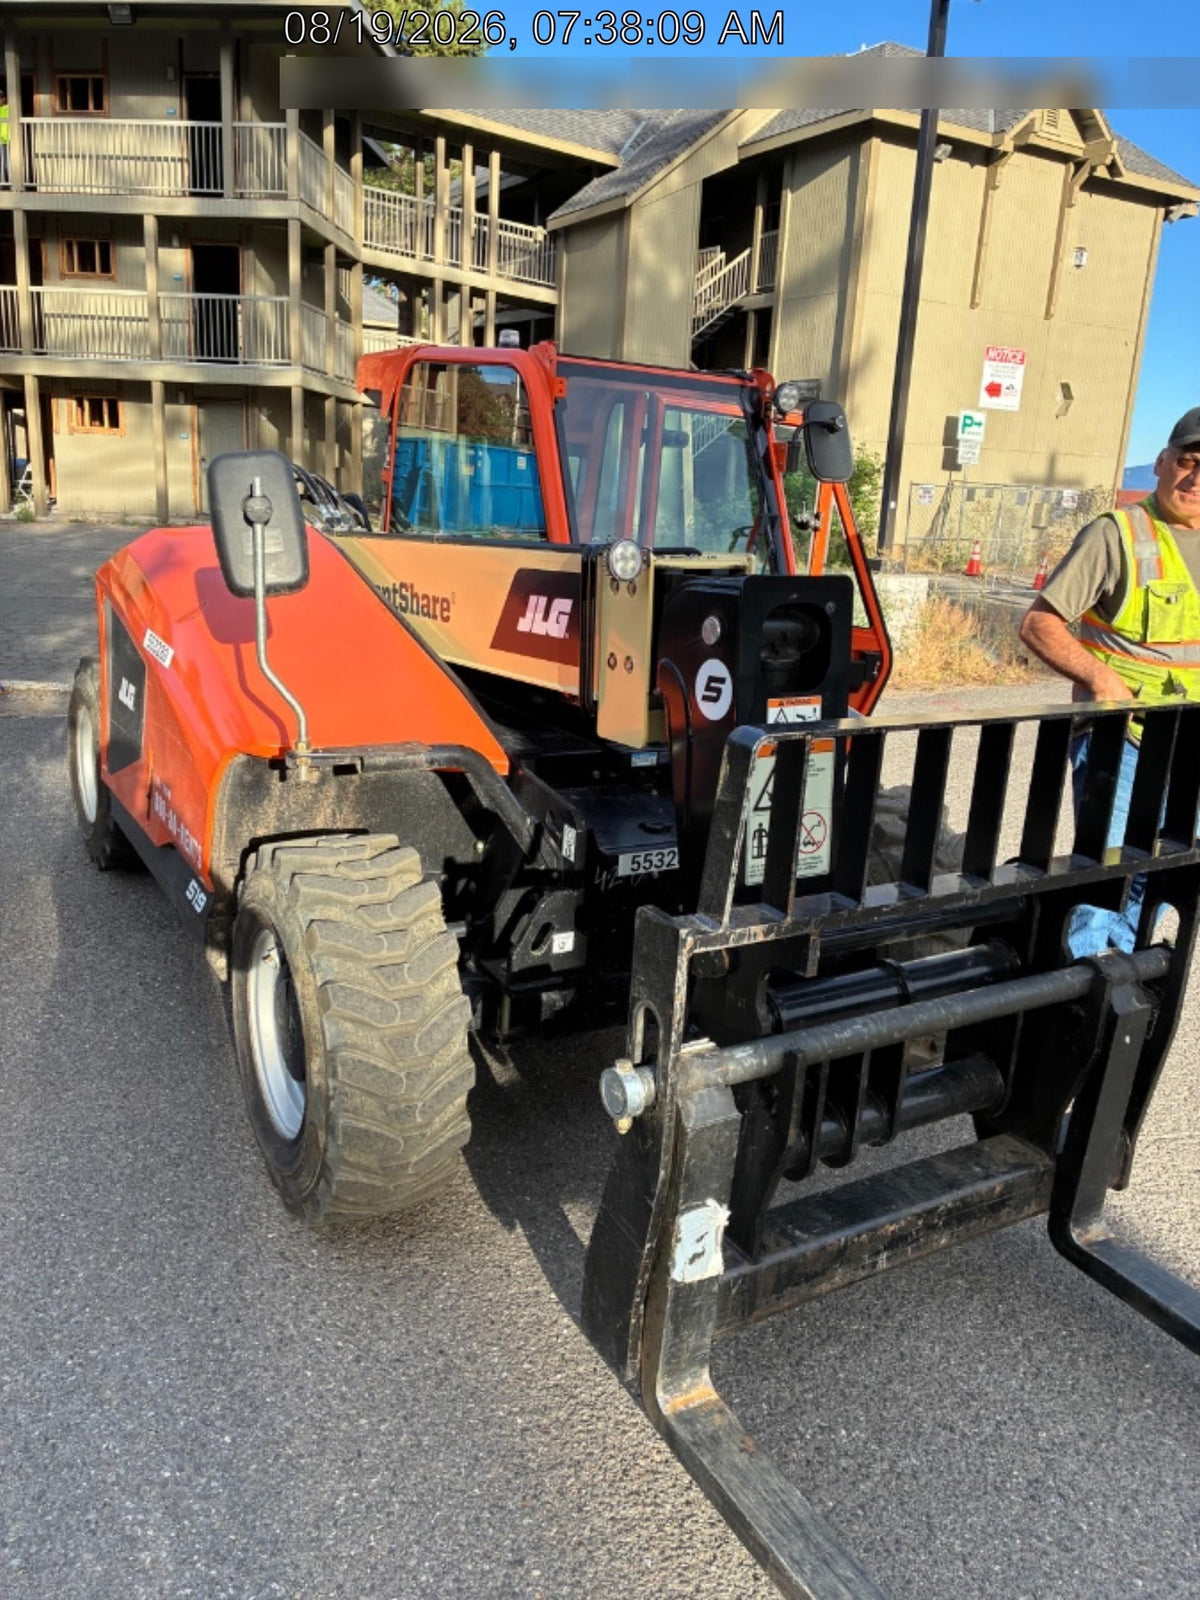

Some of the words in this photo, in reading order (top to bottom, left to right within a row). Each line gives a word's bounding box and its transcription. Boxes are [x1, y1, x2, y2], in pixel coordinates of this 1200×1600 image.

[986, 347, 1024, 364] NOTICE
[375, 581, 451, 623] ntShare
[517, 594, 573, 639] JLG
[630, 850, 677, 872] 5532
[185, 878, 207, 914] 519
